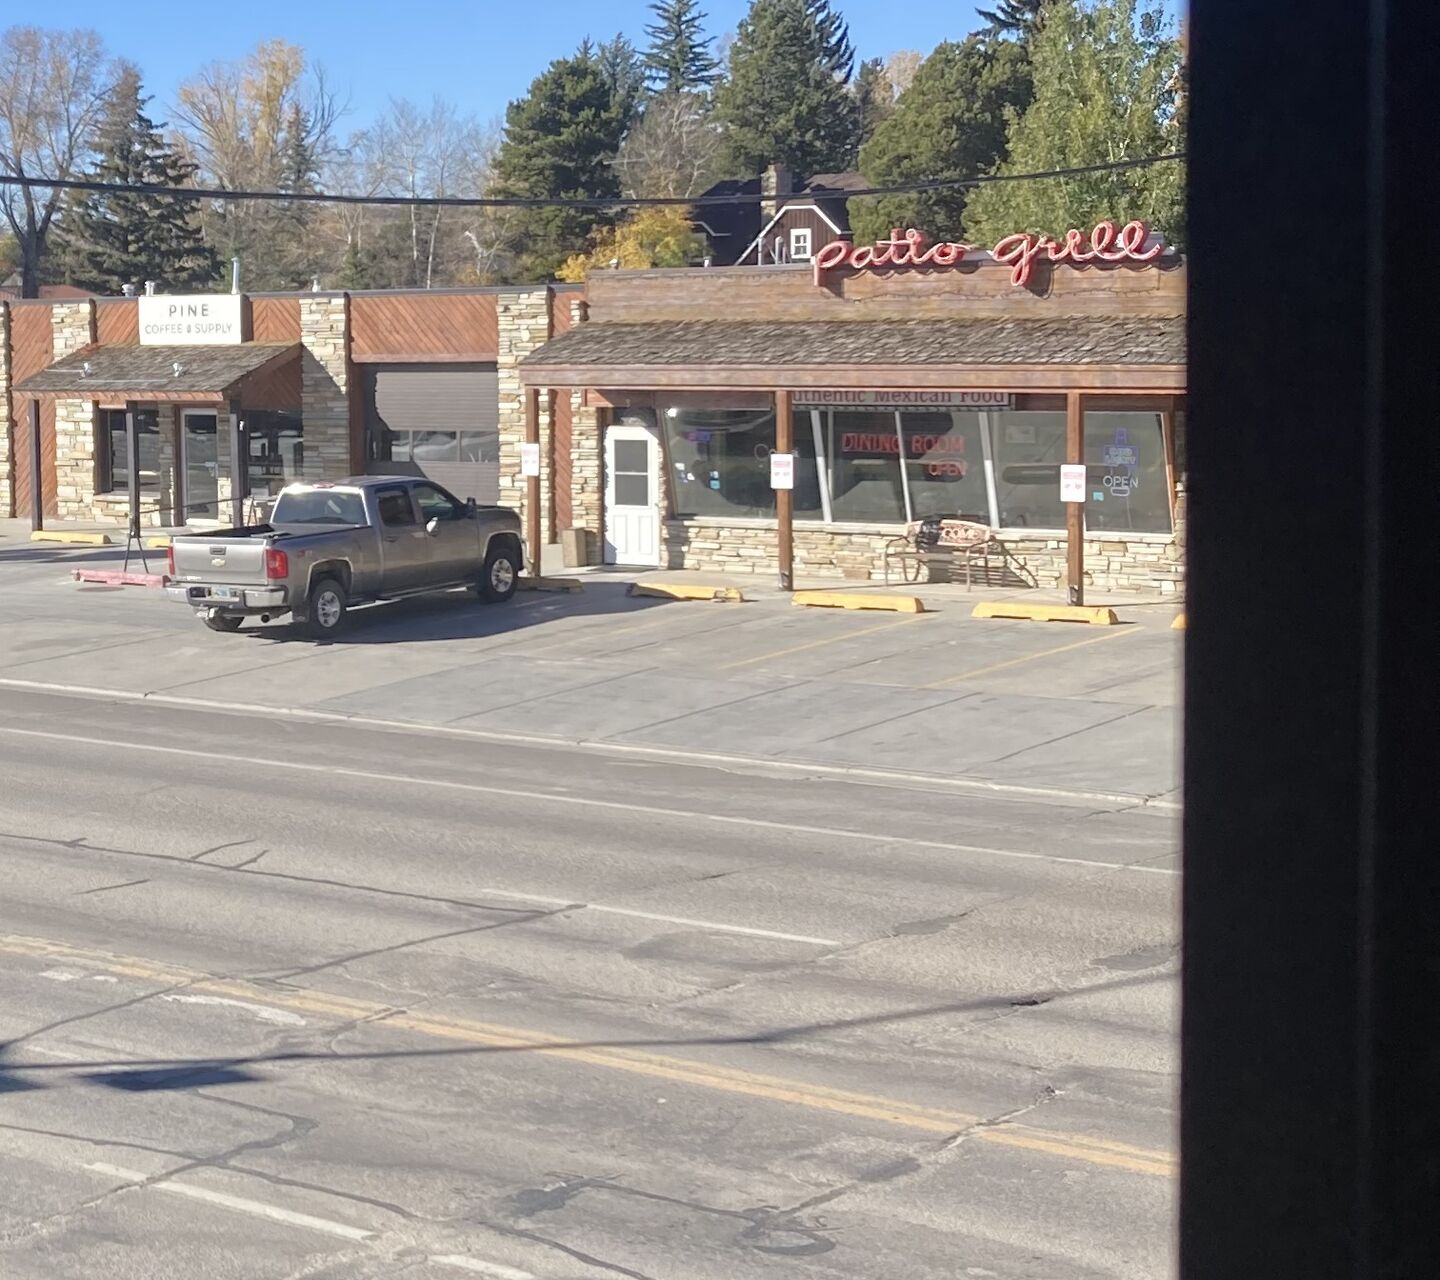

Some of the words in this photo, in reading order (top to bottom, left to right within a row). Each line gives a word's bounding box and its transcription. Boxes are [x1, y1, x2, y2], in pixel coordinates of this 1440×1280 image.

[169, 304, 209, 317] PINE
[145, 324, 183, 334] COFFEE
[194, 323, 233, 334] SUPPLY
[793, 391, 865, 402] uthentic
[873, 391, 951, 403] Mexican
[912, 435, 965, 453] ROOM
[928, 462, 967, 476] OPEN
[1103, 475, 1138, 488] OPEN
